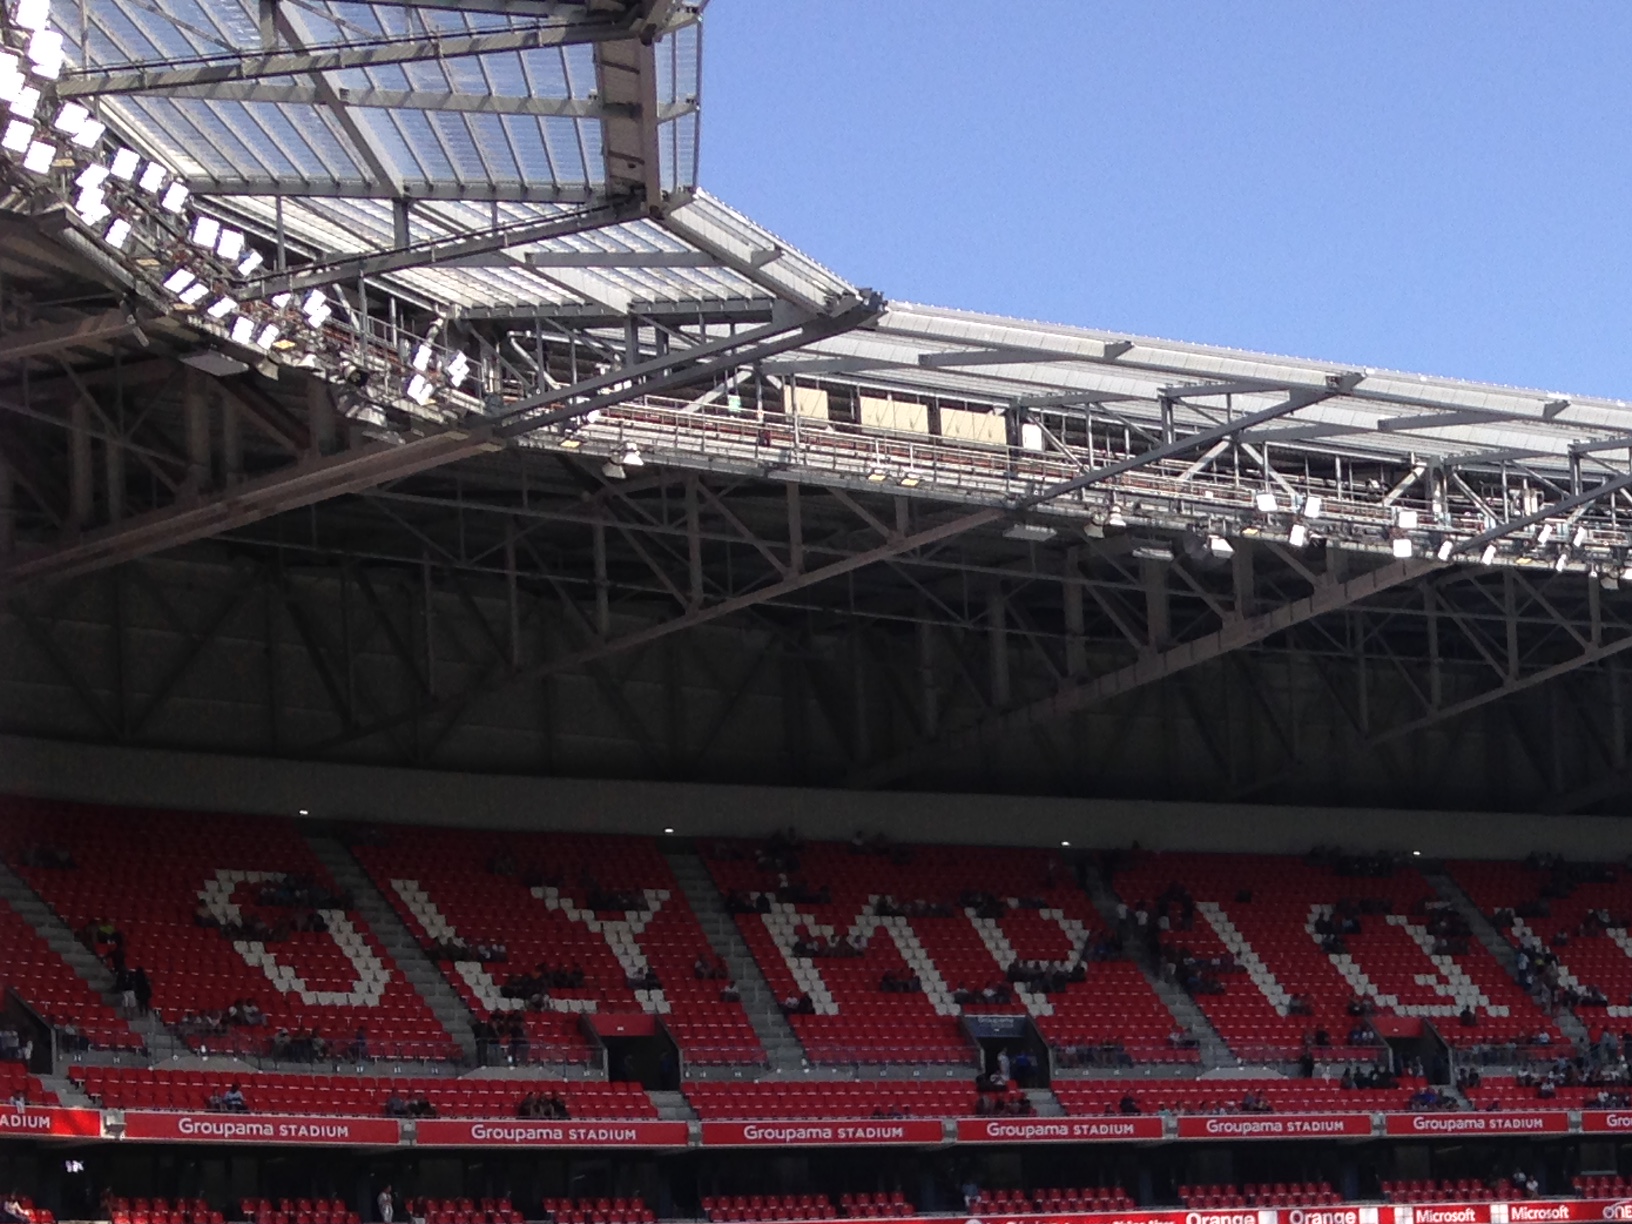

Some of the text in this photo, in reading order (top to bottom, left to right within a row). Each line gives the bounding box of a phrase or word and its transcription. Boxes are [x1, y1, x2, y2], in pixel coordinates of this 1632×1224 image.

[178, 1118, 348, 1138] Groupama STADIUM
[986, 1122, 1134, 1137] Groupama STADIUM
[1206, 1119, 1344, 1135] Groupama STADIUM
[1413, 1116, 1543, 1131] Groupama STADIUM
[471, 1124, 636, 1141] Groupama STADIUM
[744, 1124, 903, 1142] Groupama STADIUM
[1416, 1208, 1475, 1223] Microsoft
[1511, 1205, 1569, 1220] Microsoft
